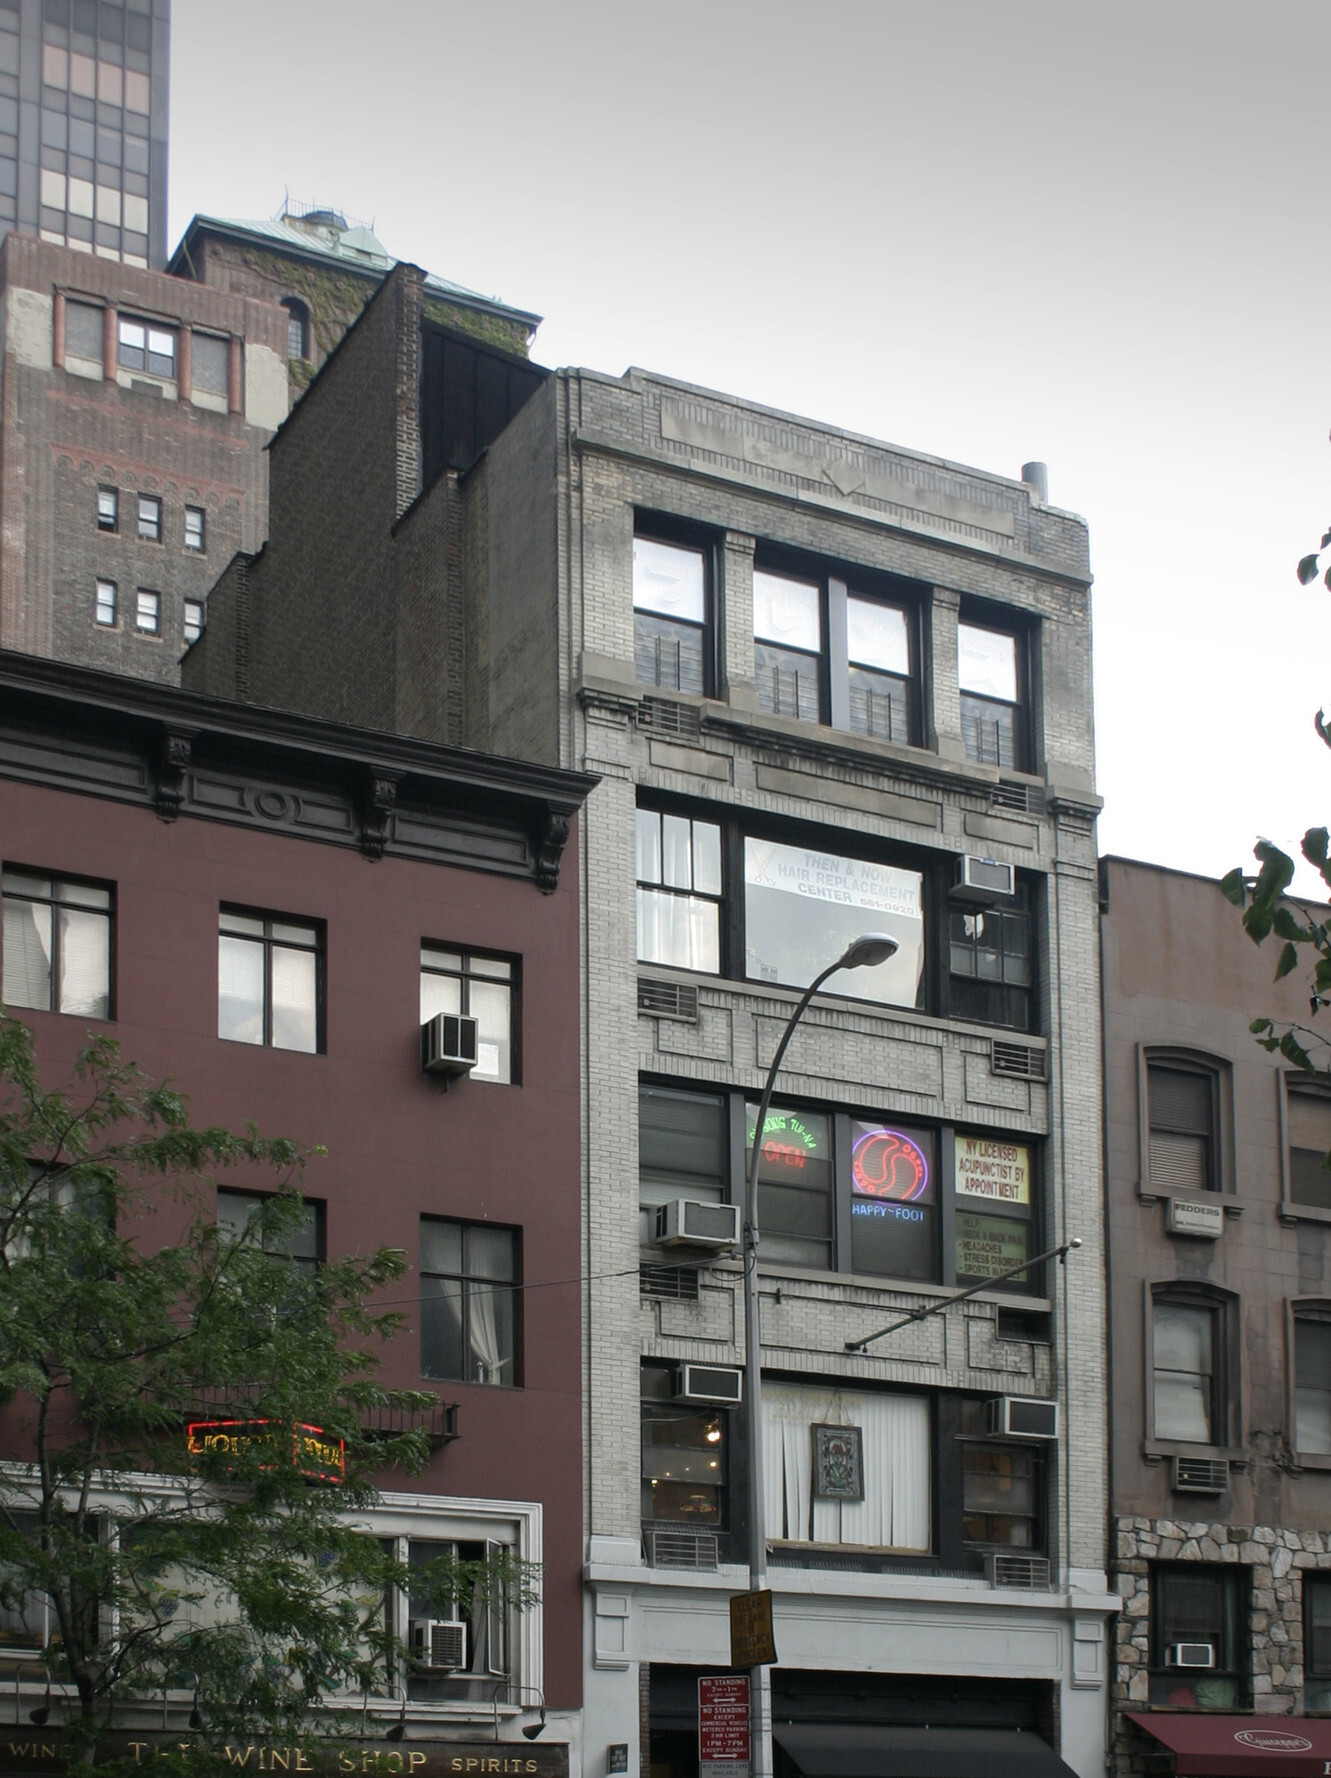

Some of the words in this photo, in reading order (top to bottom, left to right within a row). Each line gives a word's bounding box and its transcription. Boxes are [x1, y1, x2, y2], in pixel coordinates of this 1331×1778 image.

[804, 854, 840, 873] THEN
[845, 863, 854, 876] &
[861, 866, 893, 883] NOW
[778, 864, 810, 882] HAIR
[816, 872, 915, 902] REPLACEMENT
[797, 882, 852, 903] CENTER
[764, 1140, 807, 1169] OPEN
[966, 1140, 977, 1155] NY
[979, 1142, 1018, 1163] LICENSED
[959, 1157, 1012, 1180] ACUPUNCTIST
[1014, 1166, 1025, 1183] BY
[1175, 1203, 1220, 1216] FEDDERS
[963, 1252, 989, 1264] STRESS
[964, 1263, 990, 1276] SPORTS
[224, 1745, 314, 1771] WINE
[338, 1749, 428, 1774] SHOP
[451, 1757, 538, 1773] SPIRITS
